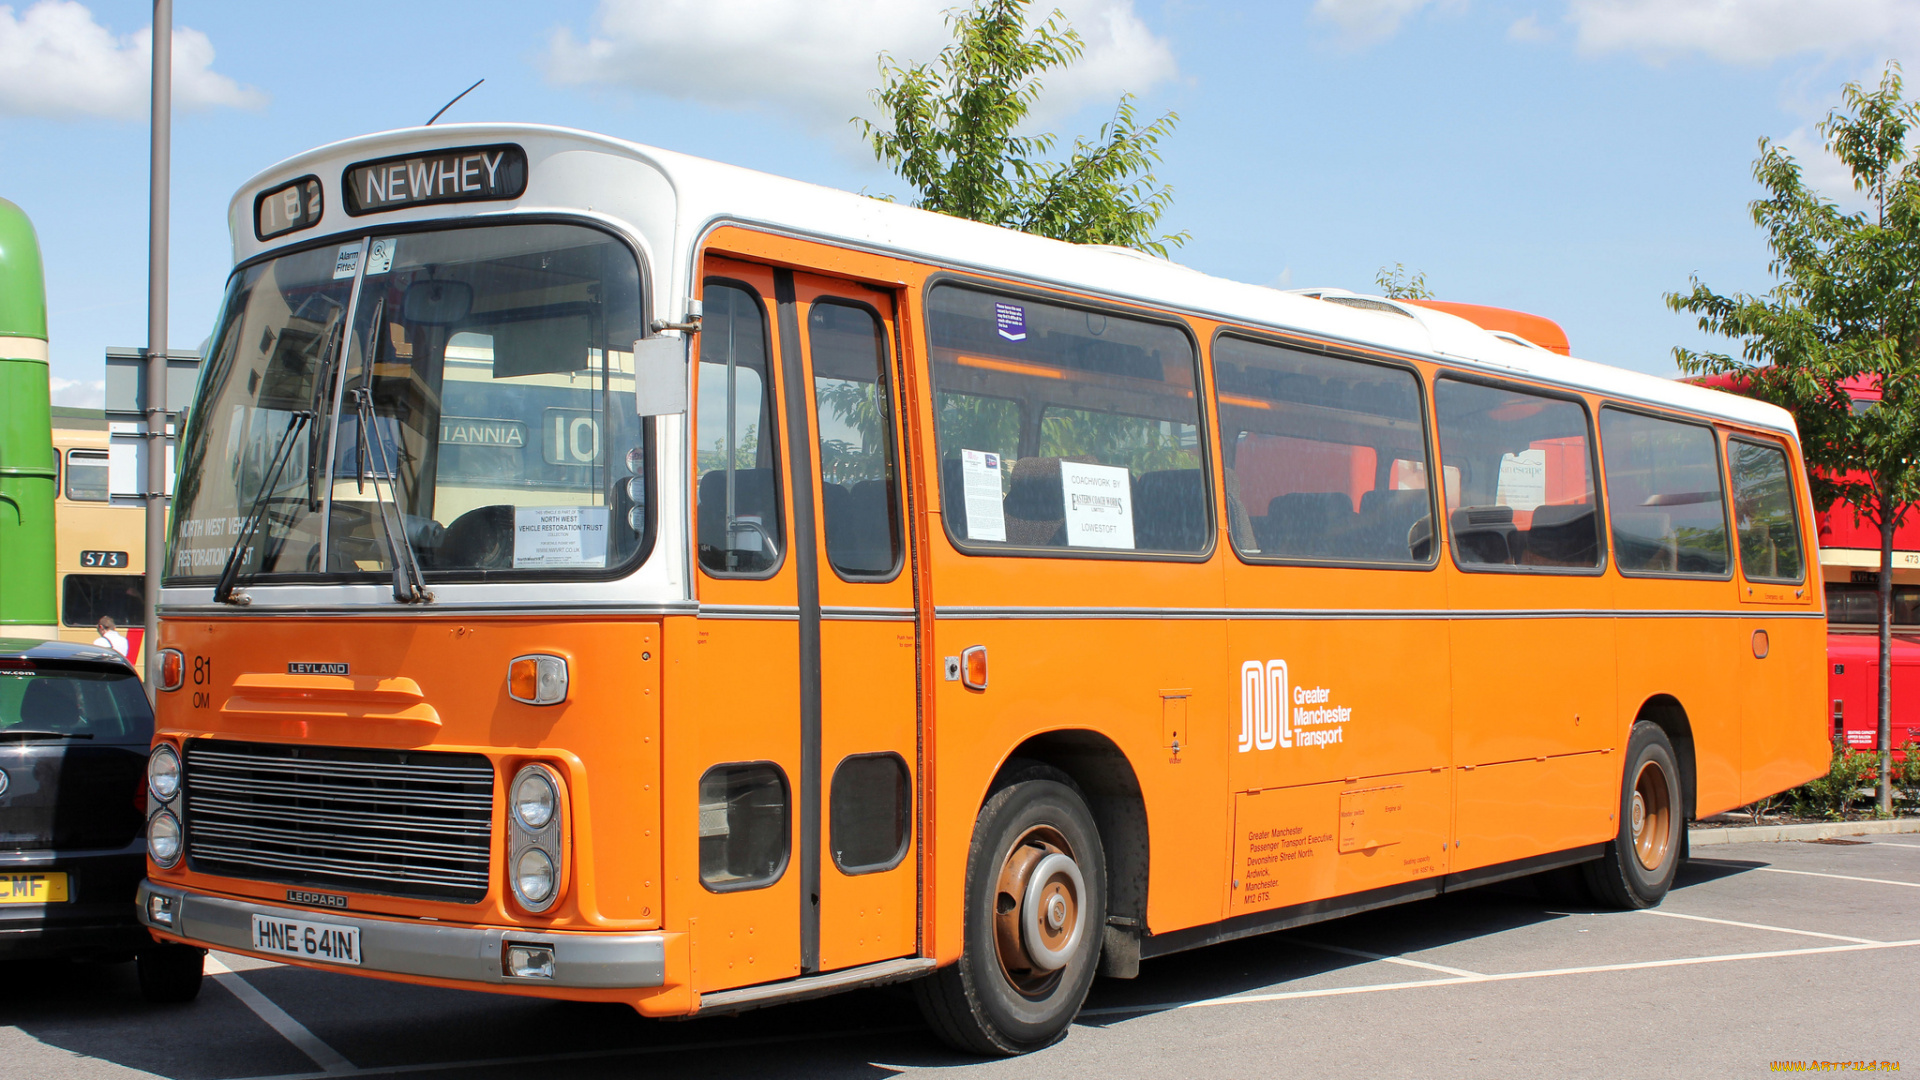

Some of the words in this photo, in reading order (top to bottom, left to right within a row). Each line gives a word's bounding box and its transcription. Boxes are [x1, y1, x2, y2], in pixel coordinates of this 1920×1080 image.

[366, 152, 504, 203] NEWHEY
[270, 181, 320, 227] 182
[338, 251, 359, 260] Alarm
[336, 261, 356, 272] Fitted
[444, 425, 523, 446] IANNIA
[555, 415, 599, 462] 10
[1071, 476, 1110, 487] COACHWORK
[1113, 480, 1120, 488] BY
[1072, 494, 1091, 510] EASTERN
[1092, 496, 1105, 506] COACH
[1106, 497, 1123, 515] WORKS
[180, 520, 203, 537] NORTH
[205, 518, 226, 536] WEST
[1081, 523, 1117, 533] LOWESTOFT
[86, 552, 118, 566] 573
[178, 547, 226, 567] RESTORATION
[1905, 555, 1919, 564] 473
[194, 656, 210, 685] 81
[291, 664, 346, 673] LEYLAND
[193, 692, 209, 709] OM
[1294, 686, 1330, 705] Greater
[1294, 705, 1352, 726] Manchester
[1294, 726, 1343, 749] Transport
[1248, 830, 1270, 841] Greater
[1271, 827, 1303, 837] Manchester
[1250, 842, 1279, 853] Passenger
[1281, 837, 1306, 848] Transport
[1247, 854, 1278, 866] Devonshire
[1280, 851, 1296, 861] Street
[0, 875, 45, 896] CMF
[290, 892, 344, 906] LEOPARD
[1244, 894, 1256, 904] M12
[259, 921, 298, 952] HNE
[305, 927, 352, 959] 641N
